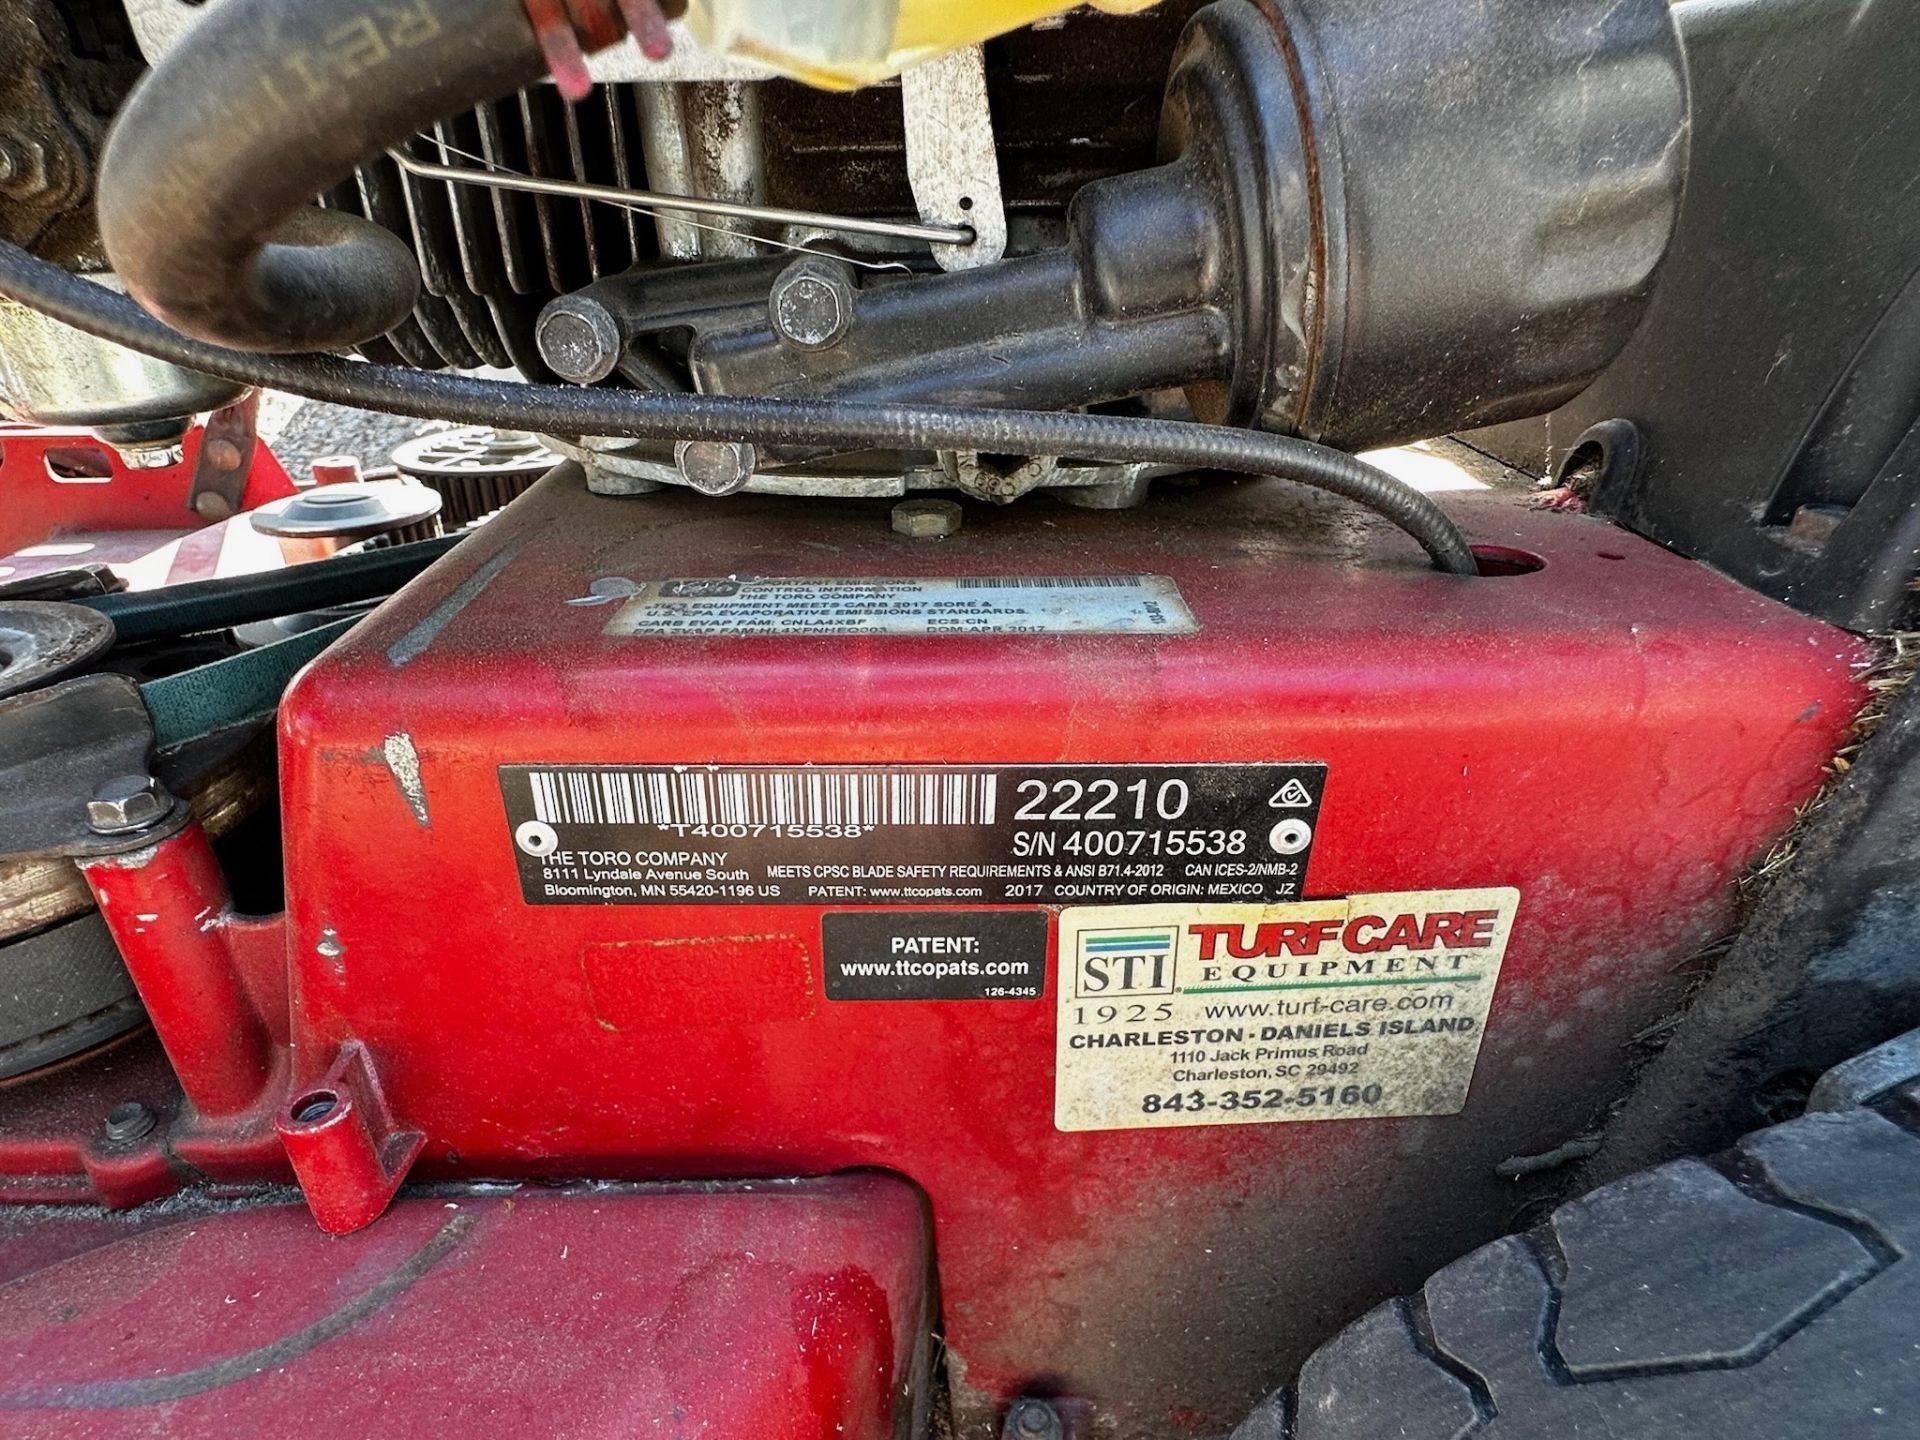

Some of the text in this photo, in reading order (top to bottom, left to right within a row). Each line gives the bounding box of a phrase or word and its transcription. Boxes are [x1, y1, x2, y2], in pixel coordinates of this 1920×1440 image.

[719, 609, 831, 617] EVAPORATIVE
[787, 601, 840, 609] MEETS
[638, 619, 684, 627] CARB
[689, 619, 732, 627] EVAP
[1013, 778, 1189, 821] 22210
[1013, 829, 1247, 857] S/N 400715538
[540, 851, 729, 866] THE TORO COMPANY
[542, 867, 750, 882] 8111 Lyndale Avenue South
[767, 864, 1299, 878] MEETS CPSC BLADE SAFETY REQUIREMENTS & ANSI B71.4-2012 CAN ICES-2/NMB-2
[545, 884, 781, 899] Bloomington, MN 55420-1196 US
[808, 883, 1295, 899] PATENT: www.ttcopats.com 2017 COUNTRY OF ORIGIN: MEXICO JZ
[890, 936, 980, 954] PATENT:
[840, 960, 1029, 980] www.ttcopats.com
[1083, 954, 1168, 992] STI
[1200, 953, 1470, 982] EQUIPMENT
[984, 987, 1037, 996] 126-4345
[1074, 1003, 1174, 1025] 1925
[1205, 993, 1454, 1020] www.turf-care.com
[1069, 1028, 1245, 1050] CHARLESTON
[1260, 1021, 1371, 1042] DANIELS
[1379, 1016, 1476, 1036] ISLAND
[1169, 1042, 1368, 1064] 1110 Jack Primus Road
[1172, 1061, 1359, 1083] Charleston, SC 29492
[1141, 1084, 1383, 1115] 843-352-5160
